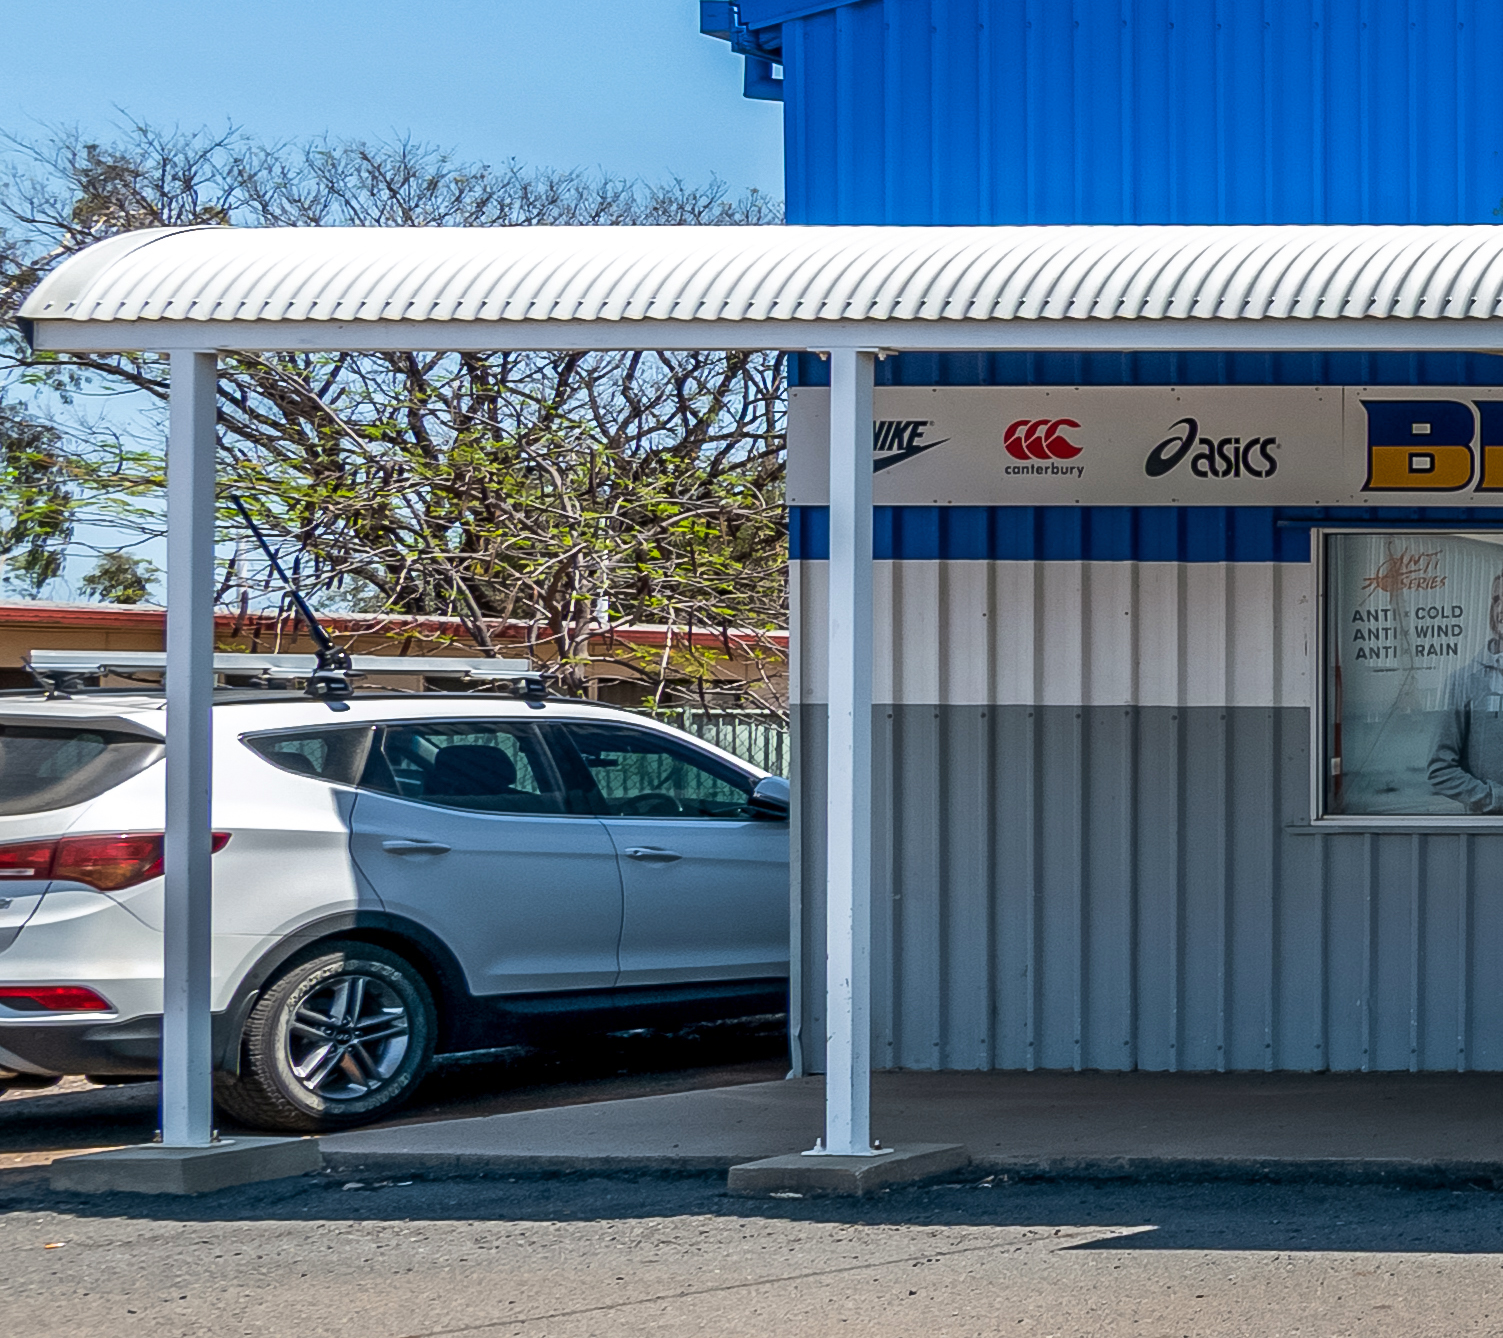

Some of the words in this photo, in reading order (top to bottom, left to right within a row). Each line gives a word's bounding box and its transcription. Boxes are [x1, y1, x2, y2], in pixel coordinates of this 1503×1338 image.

[1004, 462, 1085, 479] canterbury
[1400, 576, 1448, 592] SERIES
[1351, 608, 1397, 623] ANTI
[1415, 605, 1463, 620] COLD
[1352, 626, 1397, 642] ANTI
[1414, 623, 1463, 639] WIND
[1355, 645, 1397, 660] ANTI
[1415, 642, 1458, 658] RAIN
